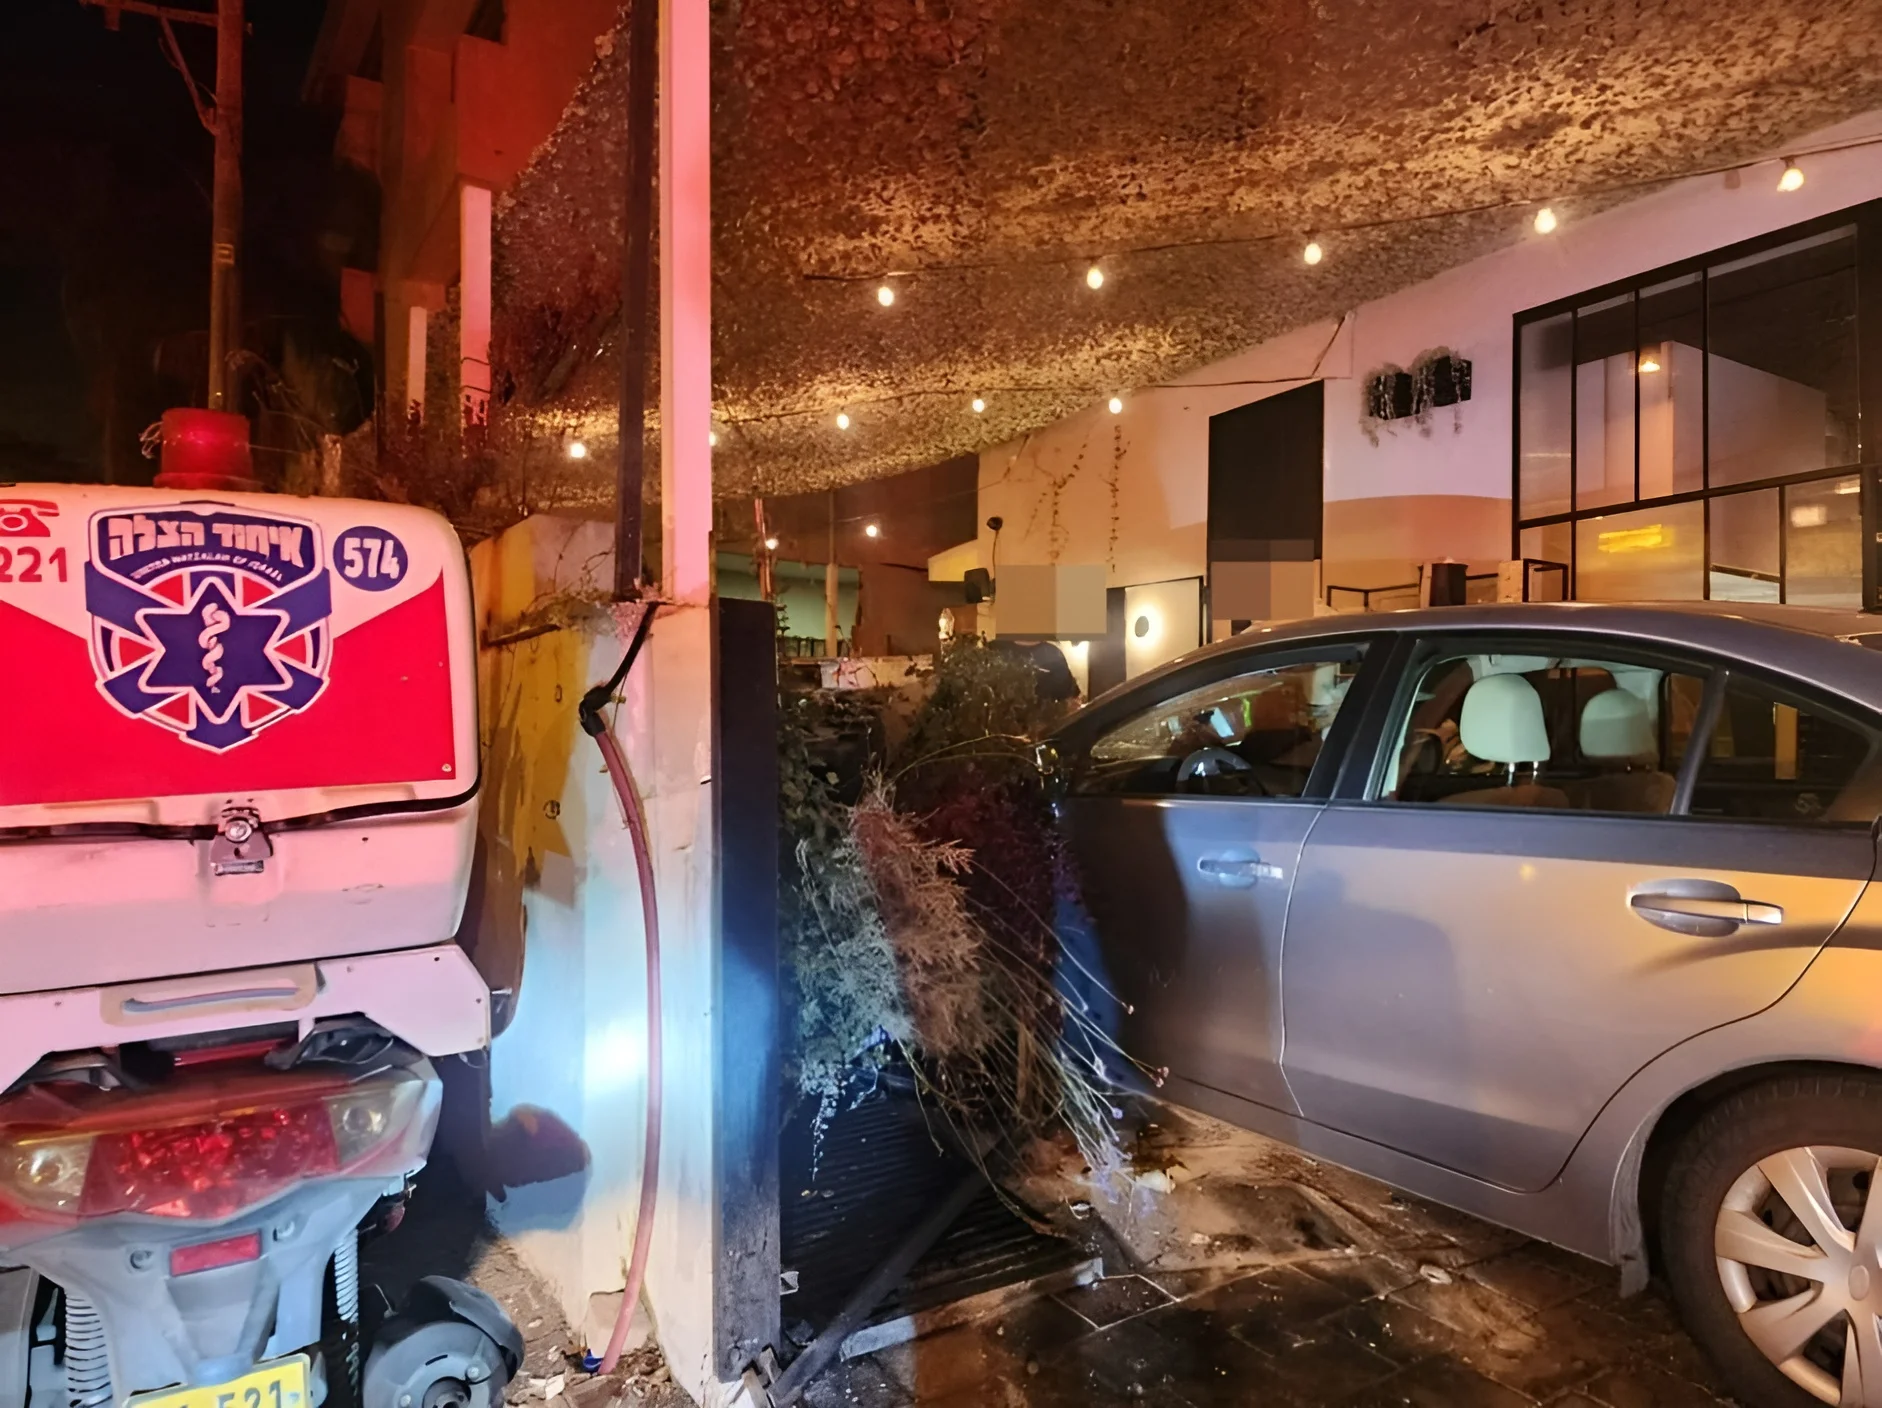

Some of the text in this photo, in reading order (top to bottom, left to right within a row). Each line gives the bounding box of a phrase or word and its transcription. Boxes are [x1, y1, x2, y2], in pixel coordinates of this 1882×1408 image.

[108, 514, 205, 561] הצלה
[212, 523, 304, 568] איחוד
[343, 537, 400, 579] 574
